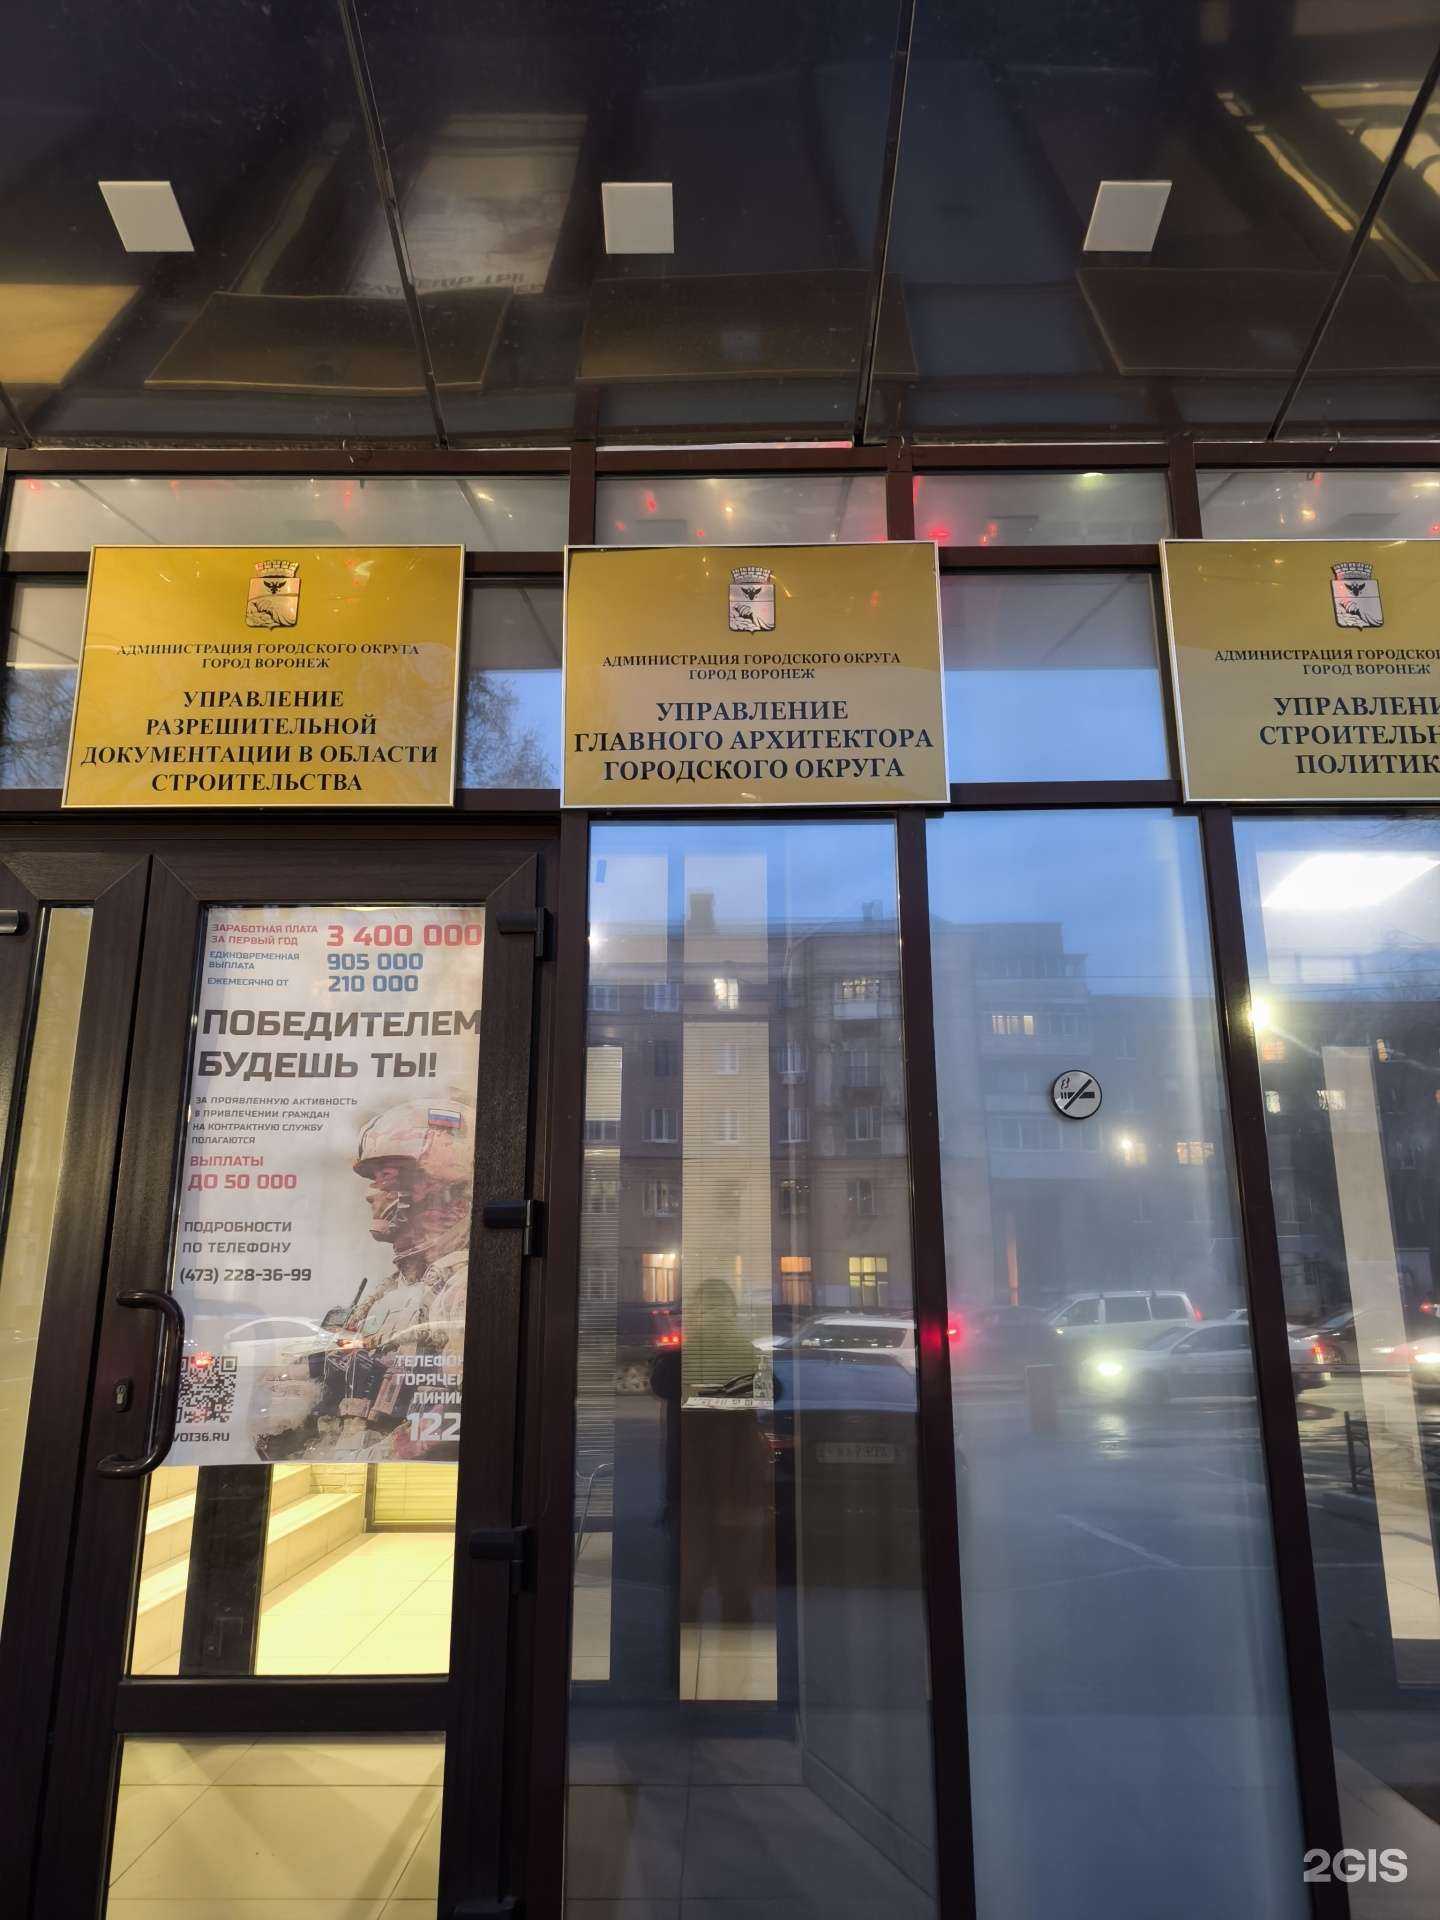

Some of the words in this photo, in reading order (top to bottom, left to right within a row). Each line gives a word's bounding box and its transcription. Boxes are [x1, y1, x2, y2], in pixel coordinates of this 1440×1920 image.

[116, 643, 252, 657] АДМИНИСТРАЦИЯ
[256, 643, 357, 656] ГОРОДСКОГО
[360, 644, 419, 656] ОКРУГА
[1215, 649, 1353, 662] АДМИНИСТРАЦИЯ
[202, 658, 251, 670] ГОРОД
[254, 657, 330, 669] ВОРОНЕЖ
[602, 654, 740, 667] АДМИНИСТРАЦИЯ
[744, 653, 840, 666] ГОРОДСКОГО
[844, 652, 900, 664] ОКРУГА
[688, 669, 738, 682] ГОРОД
[741, 668, 816, 680] ВОРОНЕЖ
[1303, 664, 1352, 676] ГОРОД
[1356, 664, 1431, 675] ВОРОНЕЖ
[184, 690, 344, 708] УПРАВЛЕНИЕ
[656, 700, 848, 722] УПРАВЛЕНИЕ
[146, 714, 377, 736] РАЗРЕШИТЕЛЬНОЙ
[574, 730, 722, 752] ГЛАВНОГО
[730, 728, 934, 750] АРХИТЕКТОРА
[80, 746, 291, 767] ДОКУМЕНТАЦИИ
[299, 746, 314, 763] В
[320, 745, 438, 764] ОБЛАСТИ
[603, 759, 787, 784] ГОРОДСКОГО
[795, 758, 904, 778] ОКРУГА
[1296, 754, 1440, 774] ПОЛИТИК
[151, 774, 362, 792] СТРОИТЕЛЬСТВА
[213, 924, 282, 933] ЗАРАБОТНАЯ
[285, 925, 318, 934] ПЛАТА
[326, 925, 344, 946] 3
[353, 924, 412, 946] 400
[423, 924, 483, 946] 000
[211, 936, 225, 944] ЗА
[228, 936, 275, 945] ПЕРВЫЙ
[278, 937, 298, 946] ГОД
[208, 950, 300, 960] ЕДИНОВРЕМЕННАЯ
[327, 953, 370, 970] 905
[377, 953, 424, 970] 000
[208, 961, 256, 970] ВЫПЛАТА
[208, 977, 274, 986] ЕЖЕМЕСЯЧНО
[328, 975, 365, 992] 210
[372, 975, 419, 992] 000
[202, 1009, 481, 1041] ПОБЕДИТЕЛЕМ
[197, 1050, 359, 1082] БУДЕШЬ
[370, 1052, 438, 1078] ТЫ!
[195, 1096, 208, 1104] ЗА
[210, 1097, 290, 1105] ПРОЯВЛЕННУЮ
[292, 1098, 358, 1106] АКТИВНОСТЬ
[204, 1110, 279, 1118] ПРИВЛЕЧЕНИИ
[192, 1123, 206, 1131] НА
[282, 1124, 324, 1132] СЛУЖБУ
[192, 1136, 256, 1144] ПОЛАГАЮТСЯ
[190, 1156, 264, 1167] ВЫПЛАТЫ
[188, 1174, 218, 1192] ДО
[224, 1174, 250, 1189] 50
[256, 1174, 298, 1190] 000
[184, 1221, 292, 1234] ПОДРОБНОСТИ
[182, 1242, 202, 1253] ПО
[208, 1242, 292, 1254] ТЕЛЕФОНУ
[180, 1268, 219, 1284] (473)
[224, 1268, 312, 1282] 228-36-99
[407, 1412, 461, 1441] 122
